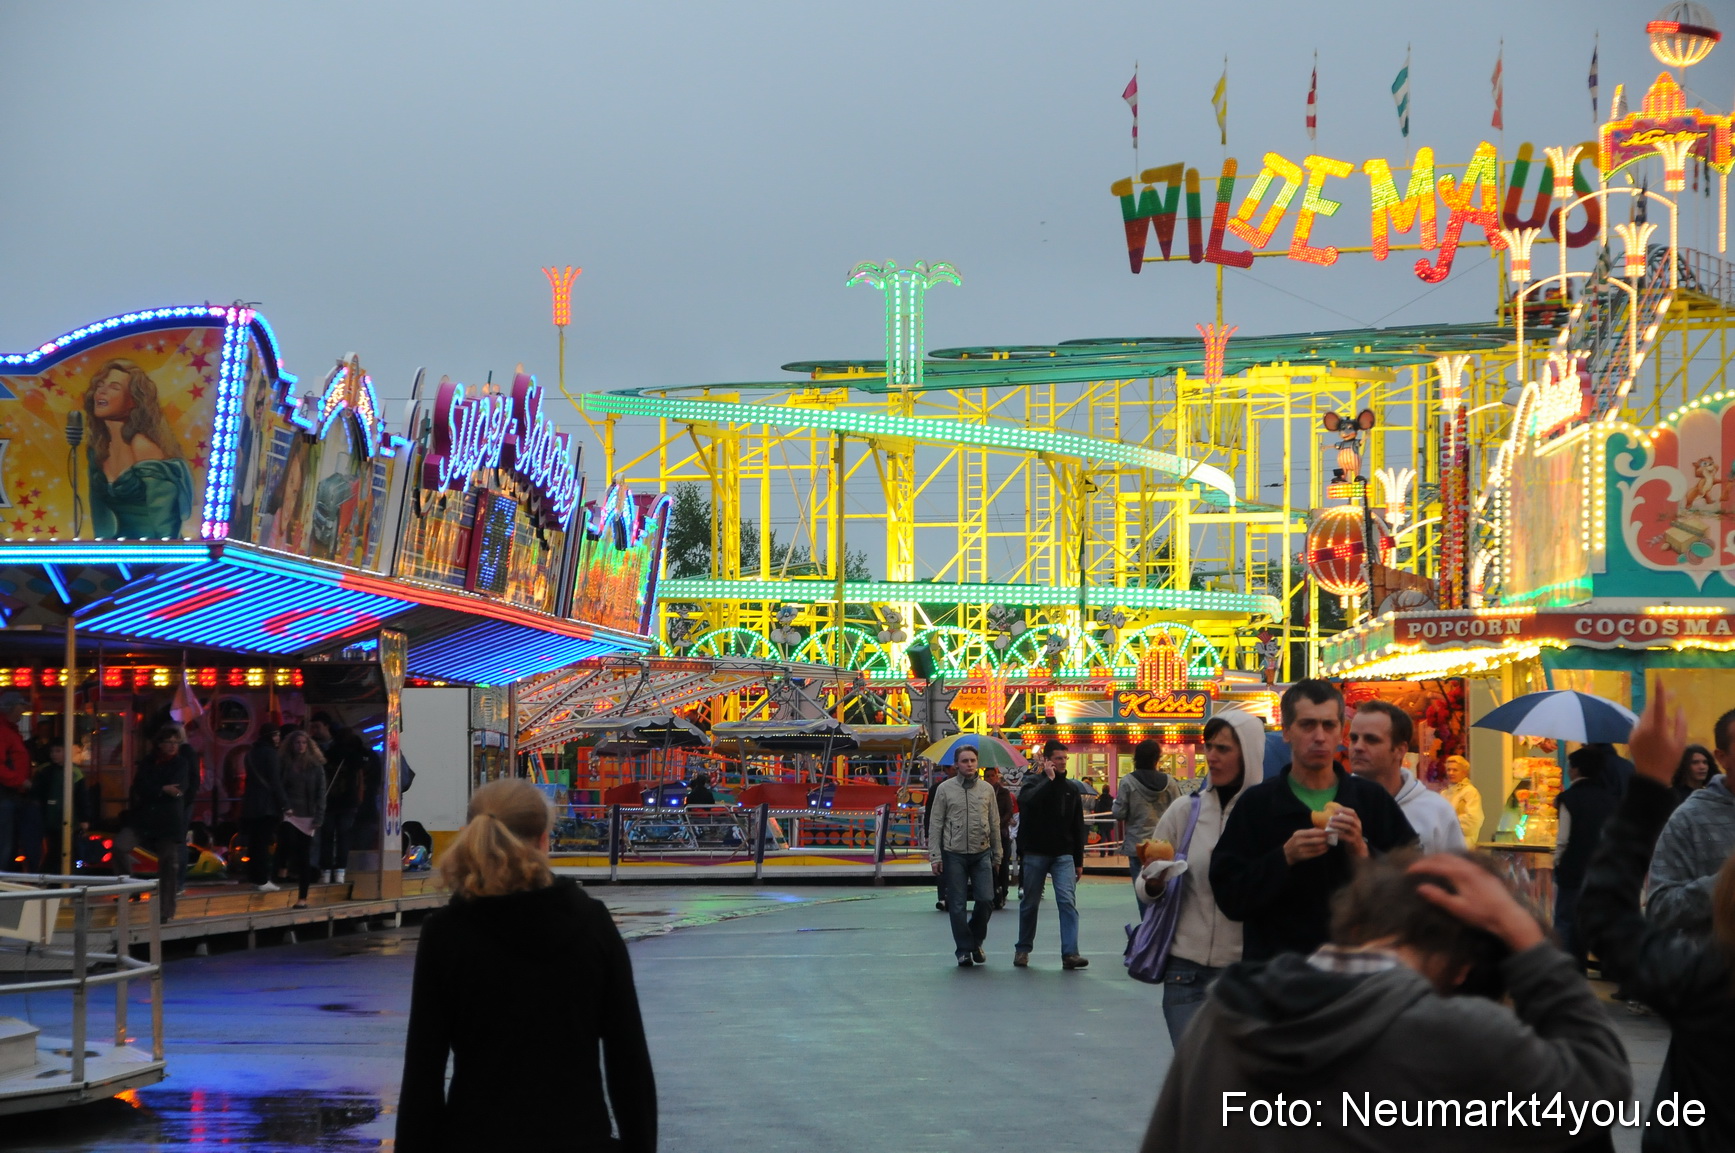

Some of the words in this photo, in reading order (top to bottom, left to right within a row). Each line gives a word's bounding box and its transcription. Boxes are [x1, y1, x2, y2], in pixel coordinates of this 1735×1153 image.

[1110, 150, 1354, 274] WILDE
[1363, 139, 1601, 284] MAUS
[1407, 618, 1523, 640] POPCORN
[1574, 617, 1735, 637] COCOSMA
[1118, 691, 1206, 719] Kasse
